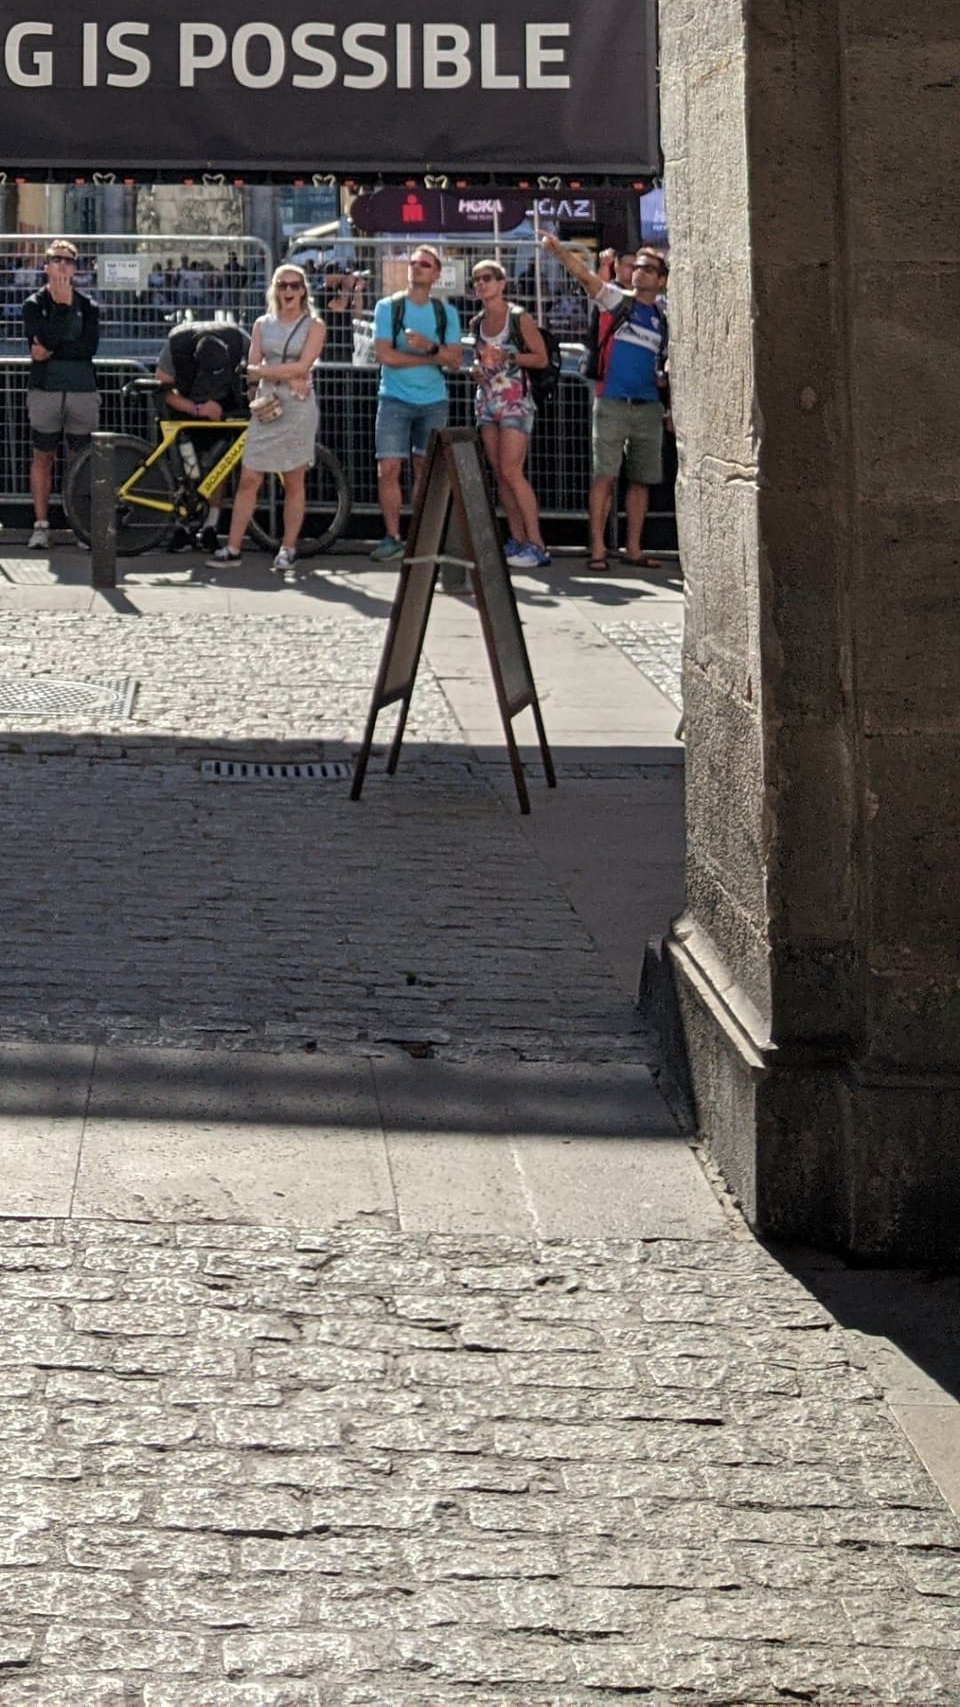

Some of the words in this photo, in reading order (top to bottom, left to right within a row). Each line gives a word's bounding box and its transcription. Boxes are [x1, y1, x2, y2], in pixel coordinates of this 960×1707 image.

[82, 21, 152, 88] IS
[179, 21, 572, 90] POSSIBLE
[458, 198, 503, 213] HOKA
[524, 197, 591, 218] GAZ
[204, 437, 247, 491] BOARDMA
